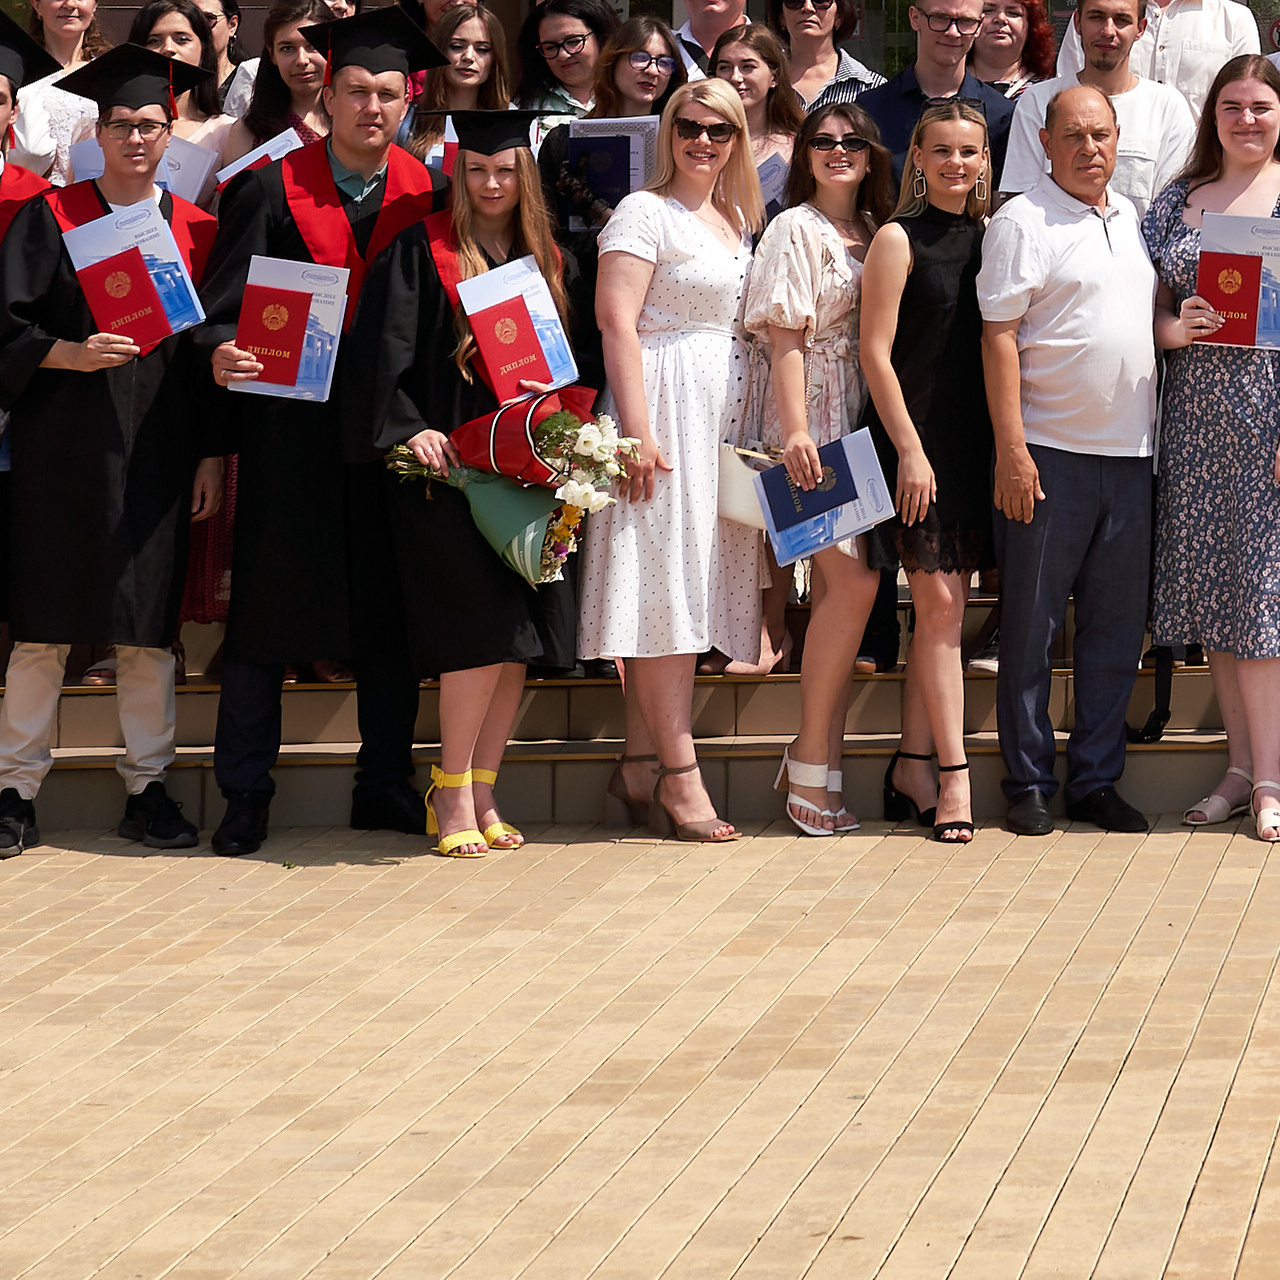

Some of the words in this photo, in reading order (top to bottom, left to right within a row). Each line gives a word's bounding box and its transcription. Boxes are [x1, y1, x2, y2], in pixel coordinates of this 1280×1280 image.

[110, 306, 153, 330] ДИПЛОМ
[247, 345, 291, 359] ДИПЛОМ
[499, 353, 537, 376] ДИПЛОМ
